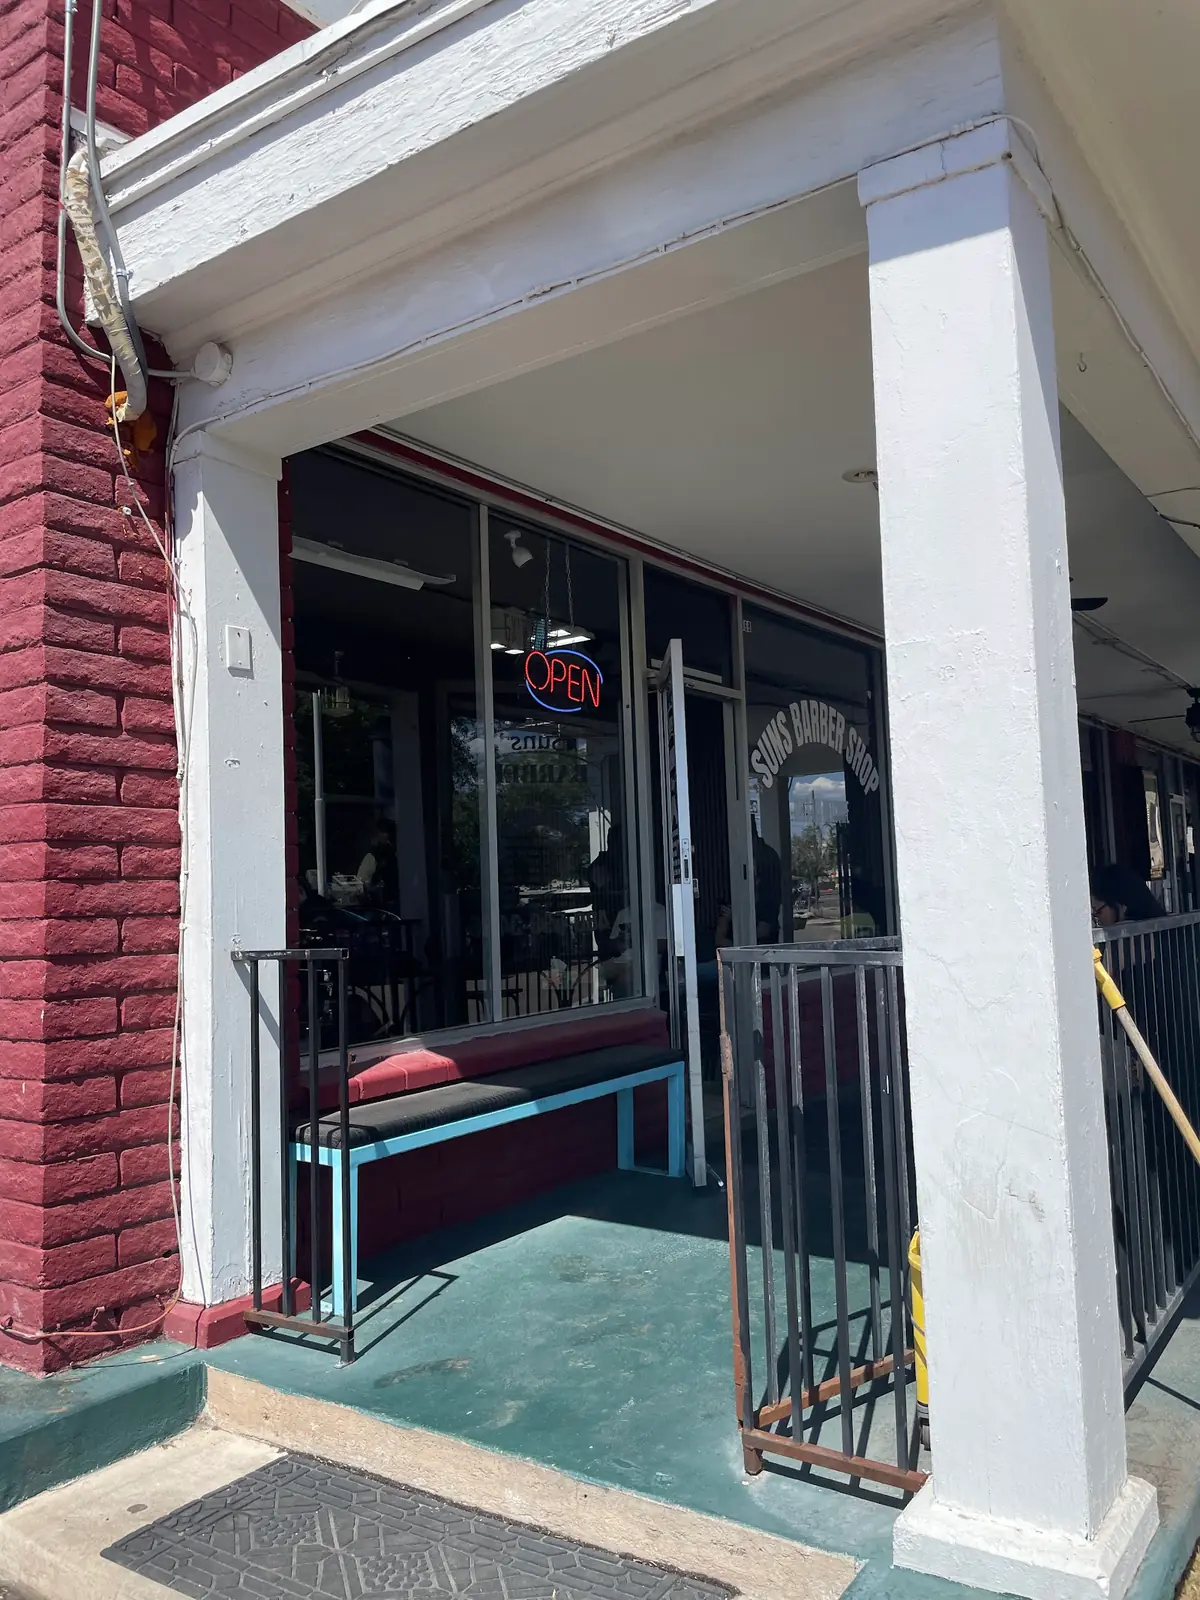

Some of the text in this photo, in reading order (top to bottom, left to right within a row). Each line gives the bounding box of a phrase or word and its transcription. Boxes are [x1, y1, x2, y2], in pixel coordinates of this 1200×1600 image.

[525, 651, 600, 707] OPEN
[751, 700, 880, 795] SUNS BARBER SHOP
